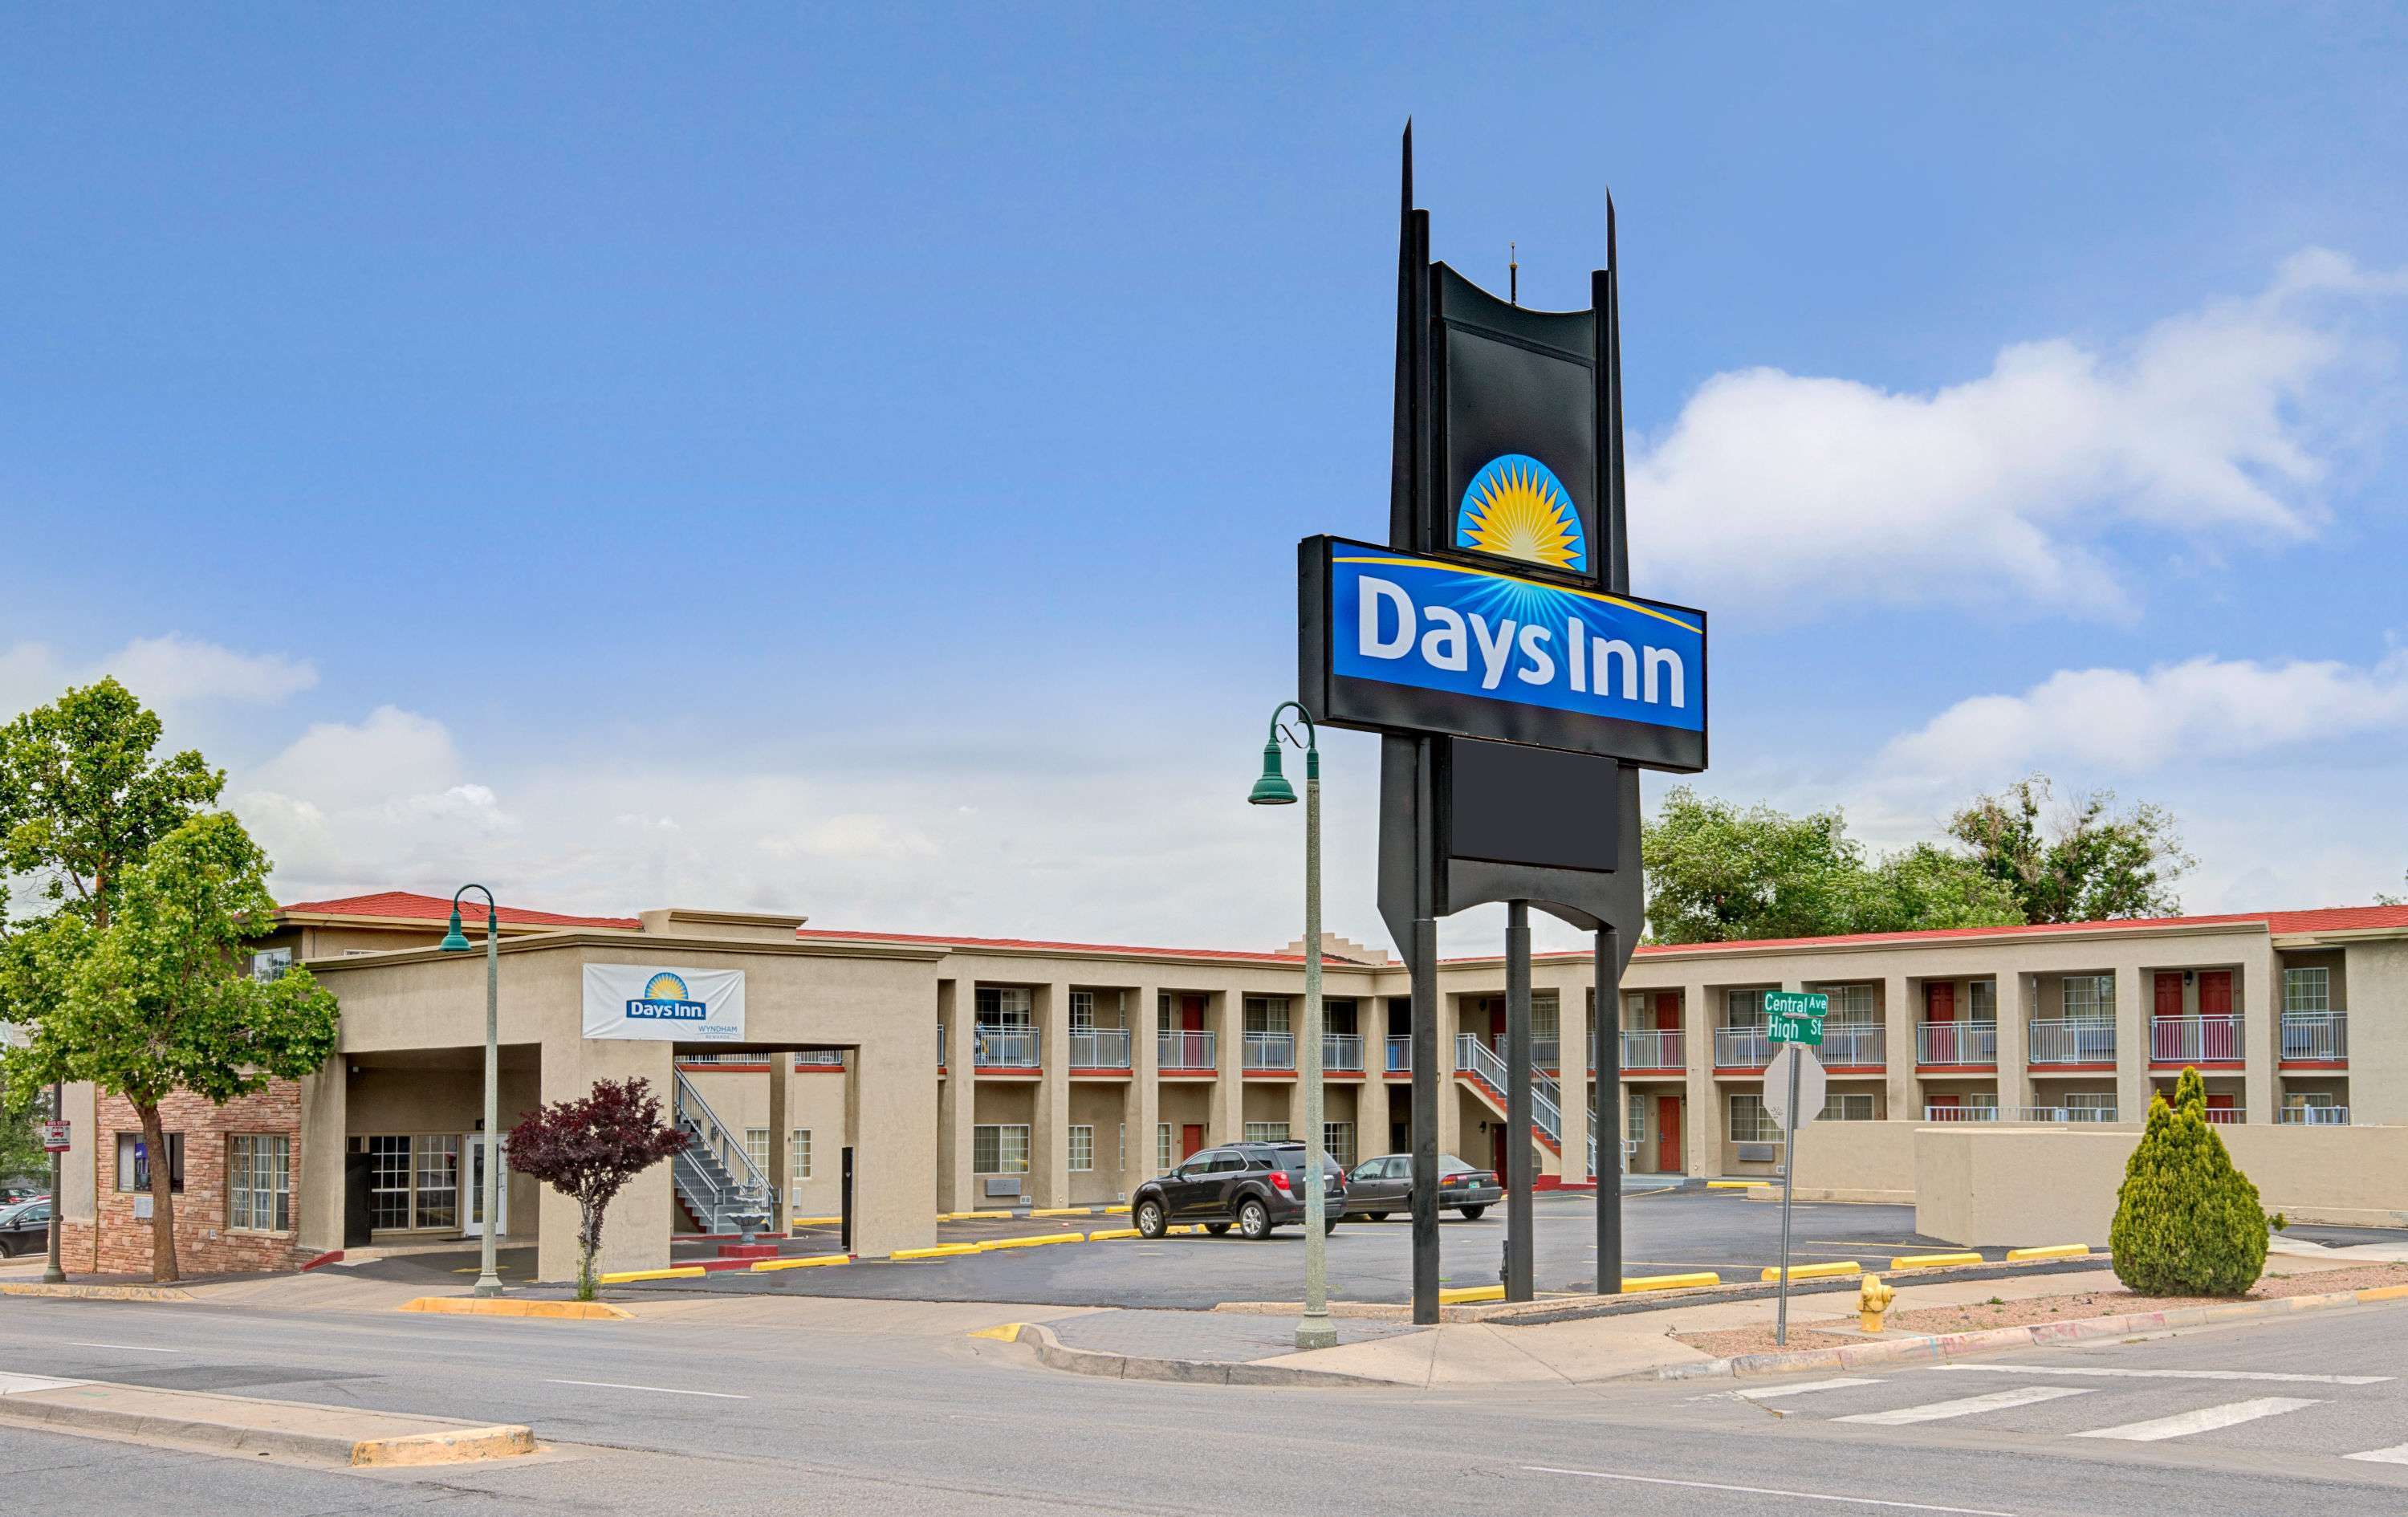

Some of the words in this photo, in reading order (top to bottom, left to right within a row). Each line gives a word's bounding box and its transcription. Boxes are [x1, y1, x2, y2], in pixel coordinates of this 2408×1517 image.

[1359, 575, 1555, 690] Days
[1568, 616, 1685, 709] Inn
[631, 1001, 673, 1018] Days
[674, 1003, 702, 1017] Inn
[1765, 994, 1808, 1012] Central
[1809, 996, 1827, 1009] Ave
[1768, 1015, 1798, 1041] High
[1811, 1019, 1821, 1035] St
